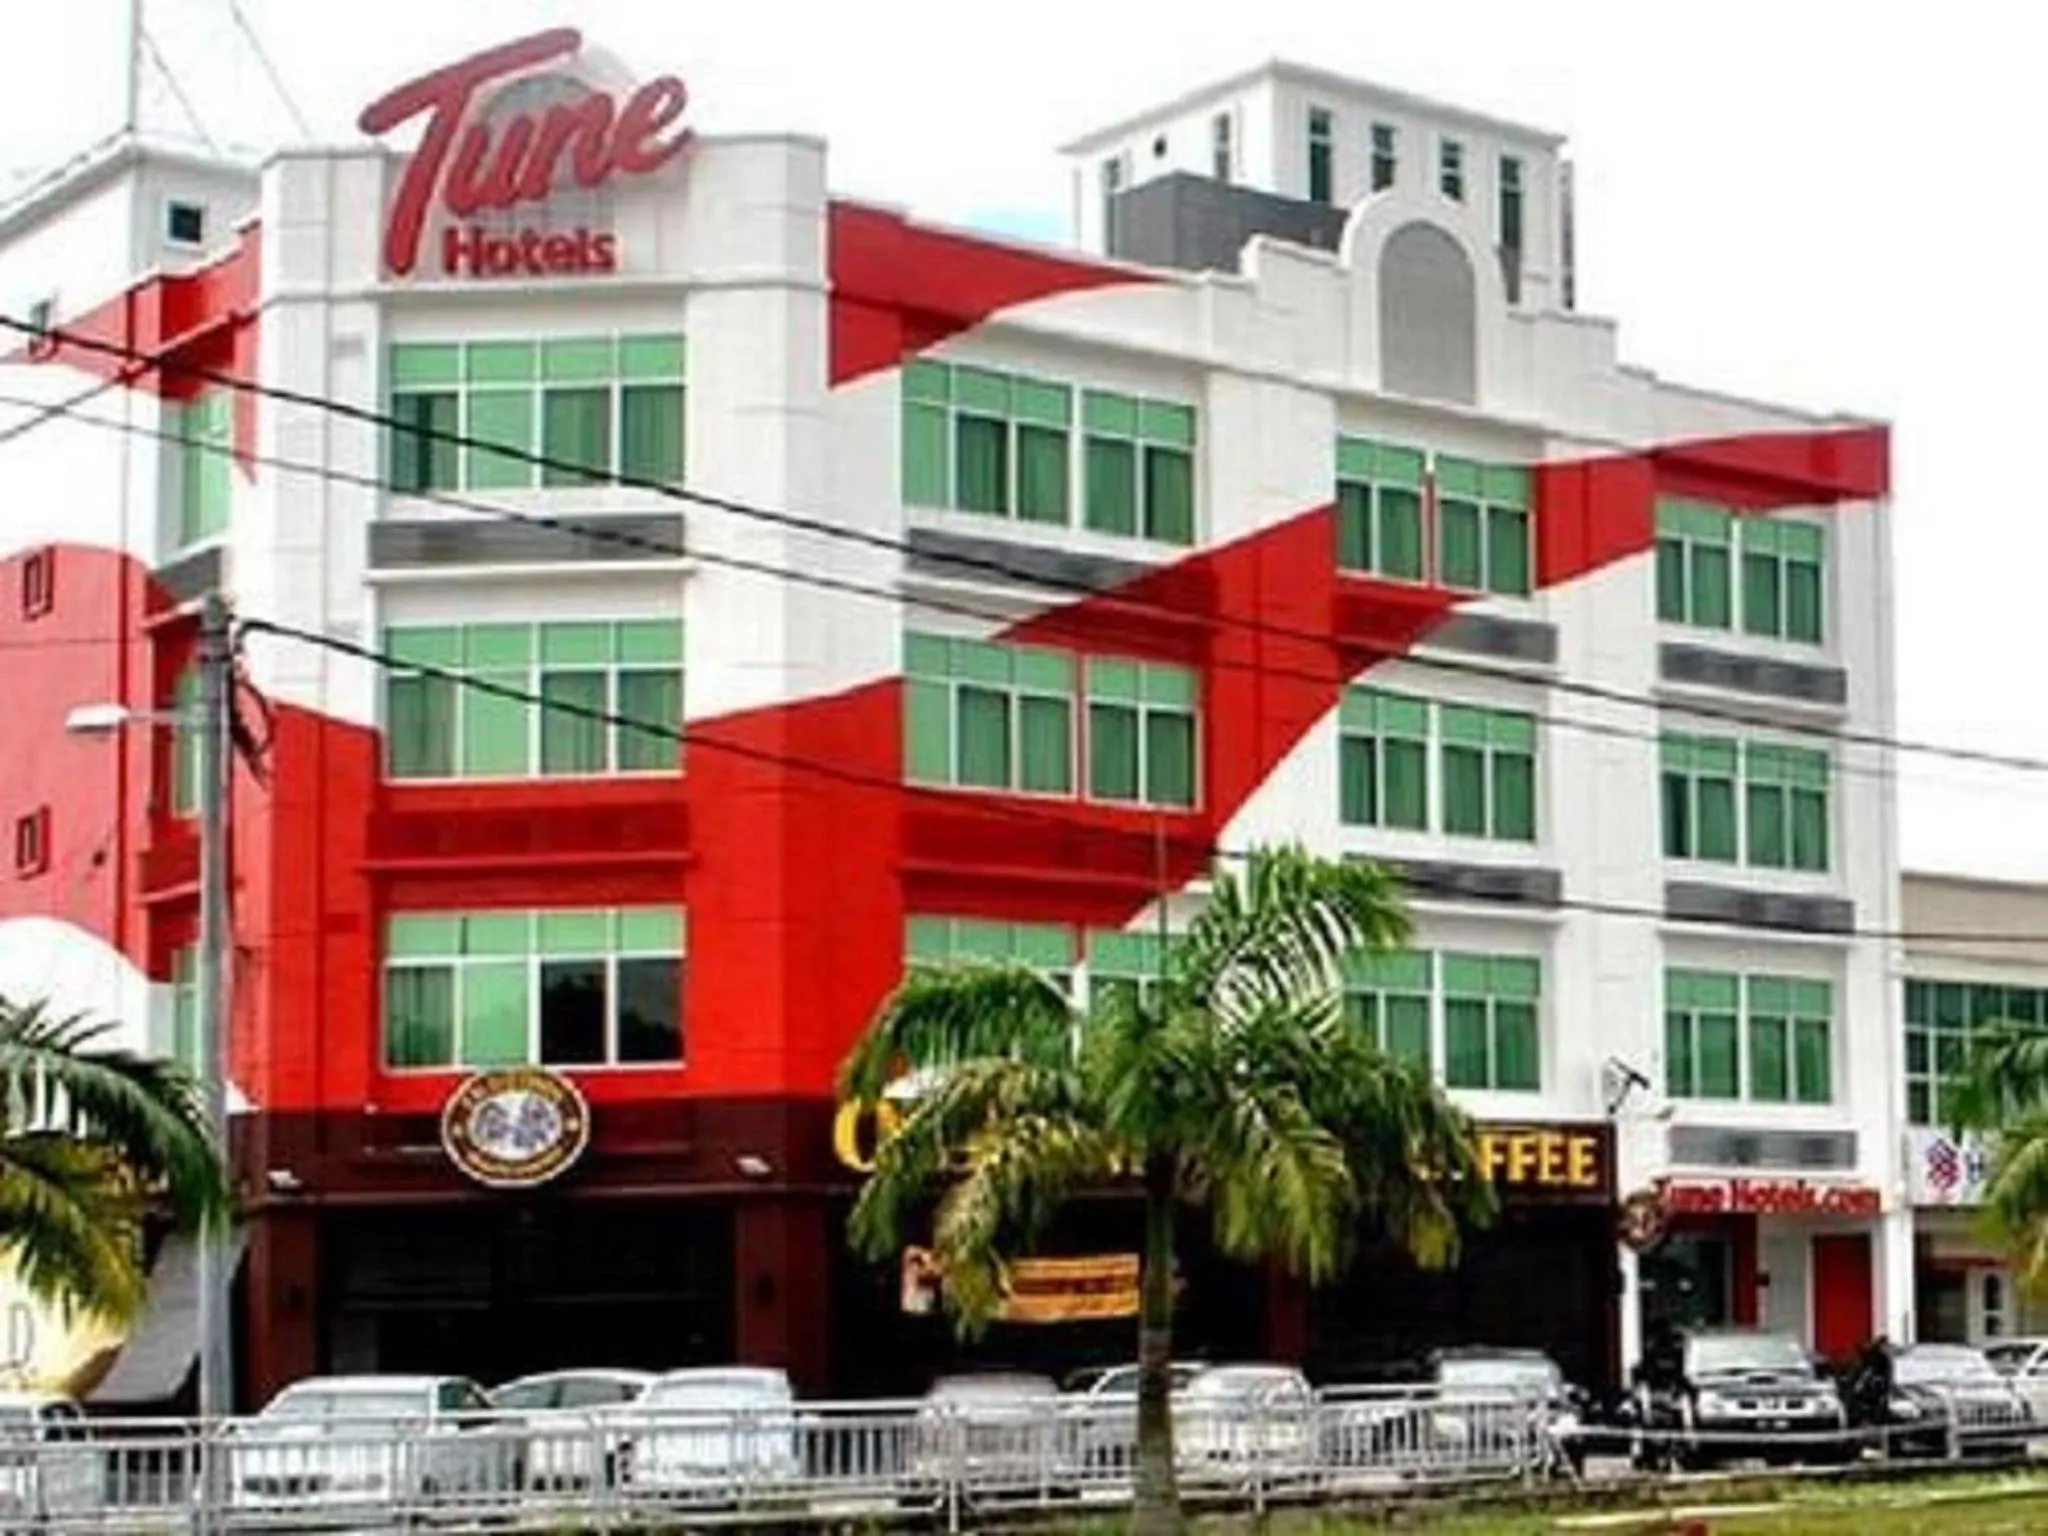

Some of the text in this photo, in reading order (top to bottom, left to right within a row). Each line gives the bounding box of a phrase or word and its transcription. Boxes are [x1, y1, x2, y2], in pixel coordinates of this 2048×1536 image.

[358, 27, 696, 275] Tune
[443, 225, 617, 275] Hotels
[1412, 1130, 1599, 1186] FFEE
[1731, 1177, 1881, 1214] Hotels.com
